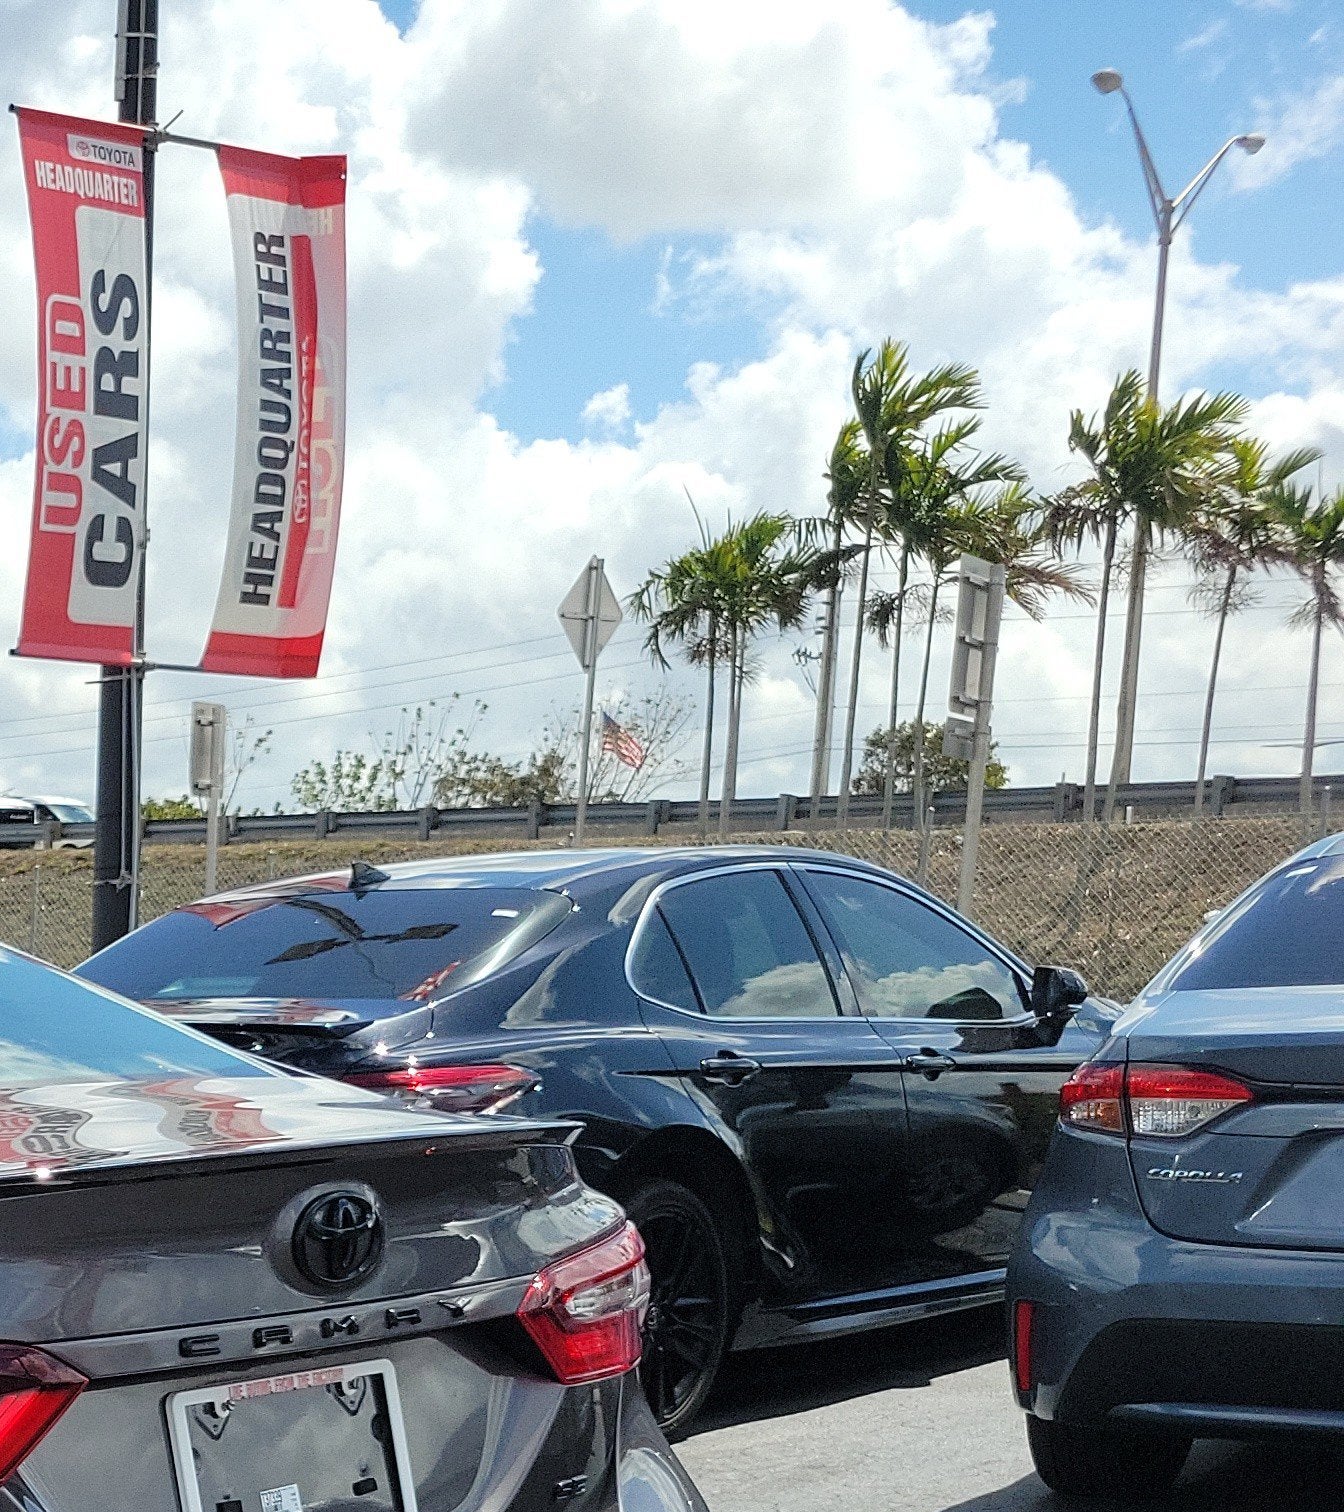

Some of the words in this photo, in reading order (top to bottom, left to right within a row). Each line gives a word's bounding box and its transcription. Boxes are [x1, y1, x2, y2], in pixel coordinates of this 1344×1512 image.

[34, 159, 139, 208] HEADQUARTER
[91, 144, 136, 168] TOYOTA
[39, 294, 86, 533] USED
[84, 269, 140, 589] CARS
[238, 230, 296, 607] HEADQUARTER
[1147, 1167, 1243, 1184] COROLLA
[177, 1296, 471, 1358] CAMRY
